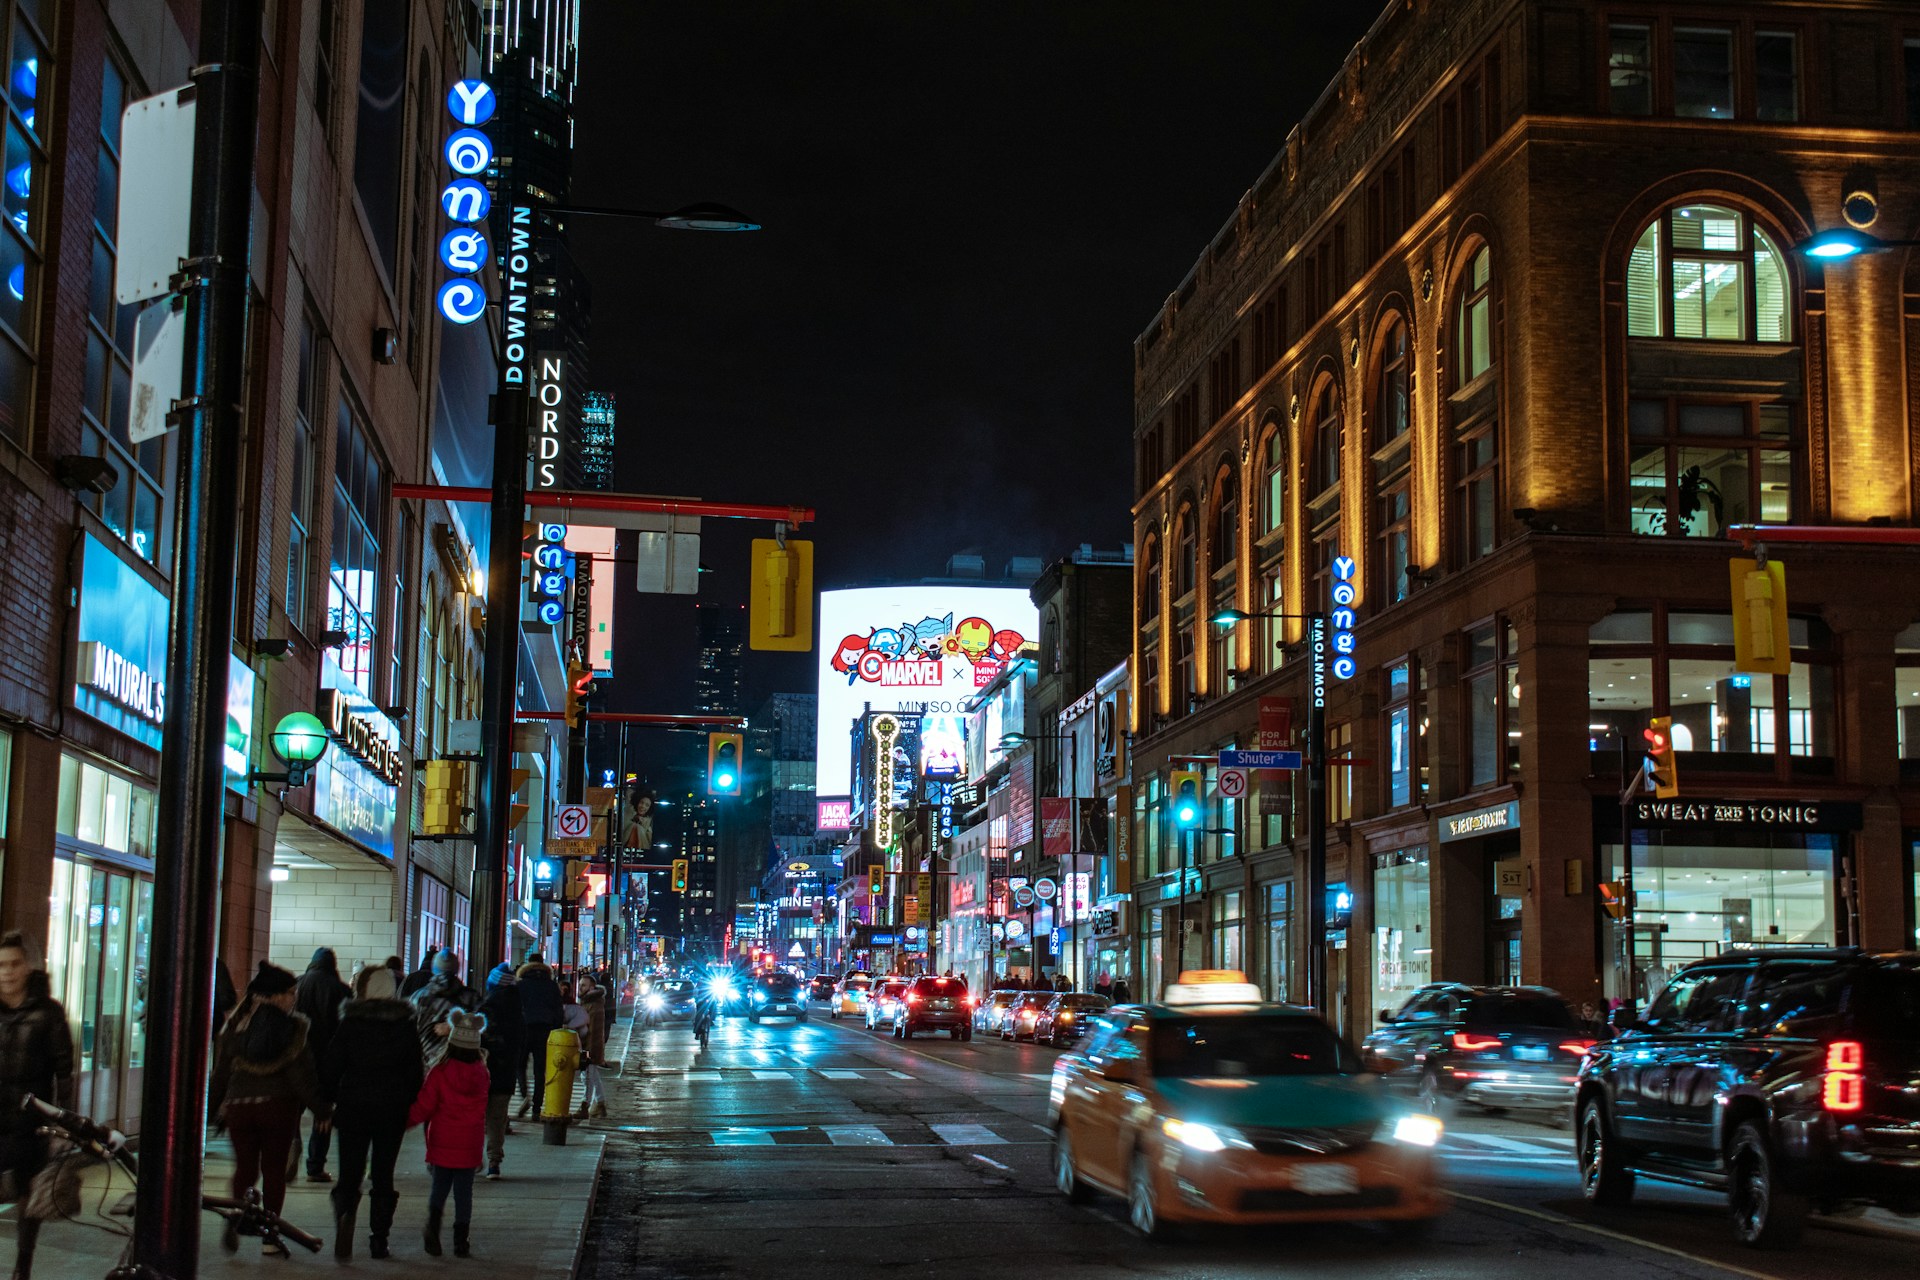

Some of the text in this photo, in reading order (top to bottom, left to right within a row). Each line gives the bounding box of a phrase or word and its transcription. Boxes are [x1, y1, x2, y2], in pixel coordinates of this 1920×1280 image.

[439, 80, 493, 324] Yonge
[506, 206, 531, 383] DOWNTOWN
[539, 523, 567, 626] onge
[1331, 556, 1356, 680] Yonge
[881, 661, 942, 686] MARVEL
[1314, 618, 1325, 708] DOWNTOWN
[880, 723, 893, 732] ED
[1261, 731, 1280, 739] FOR
[1238, 752, 1276, 765] Shuter
[881, 742, 889, 831] MIRVISH
[821, 804, 847, 819] JACK
[941, 782, 953, 838] Yonge
[1638, 803, 1819, 824] SWEAT AND TONIC
[1118, 816, 1129, 853] Payless
[1381, 962, 1400, 974] SWEAT
[1408, 961, 1428, 973] TONIC
